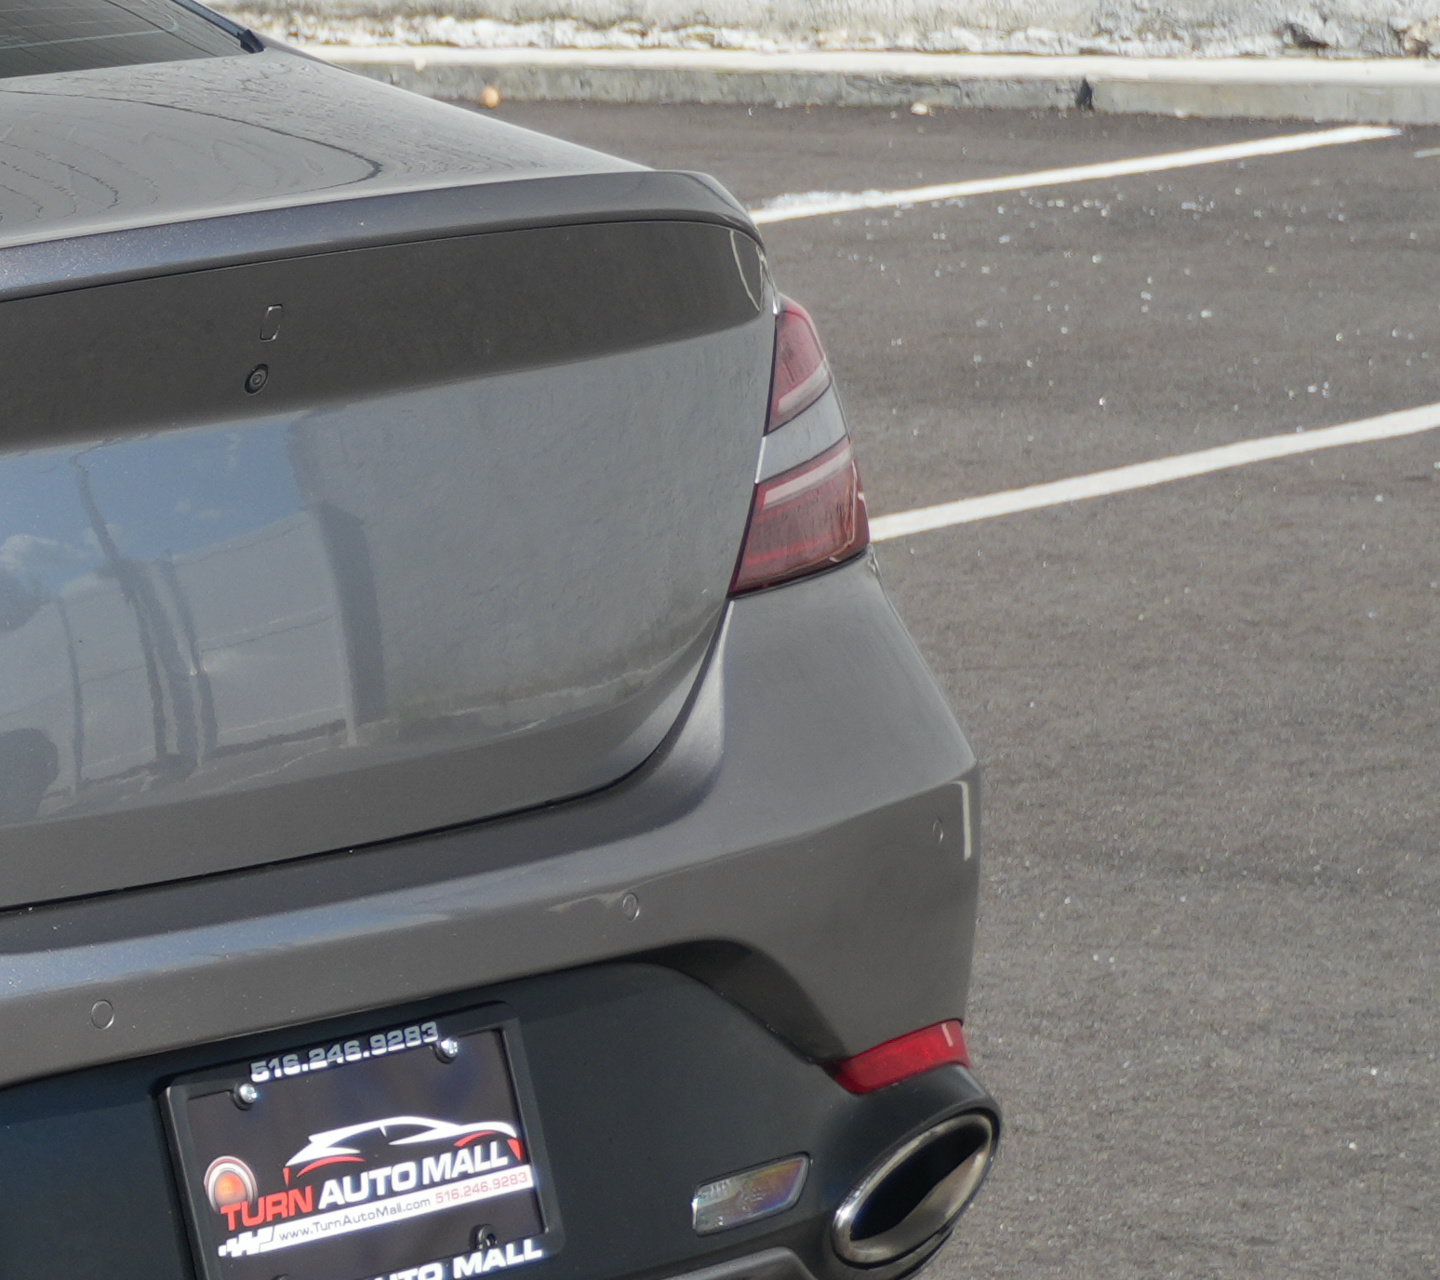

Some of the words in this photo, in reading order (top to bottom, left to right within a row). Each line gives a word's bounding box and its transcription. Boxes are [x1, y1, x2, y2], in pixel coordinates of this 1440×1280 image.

[250, 1021, 439, 1083] 516.246.9283
[220, 1185, 314, 1232] TURN
[318, 1161, 418, 1210] AUTO
[422, 1140, 509, 1186] MALL
[278, 1196, 432, 1242] www.TurnAutoMall.com
[435, 1171, 529, 1205] 516.246.9283
[452, 1238, 544, 1280] MALL
